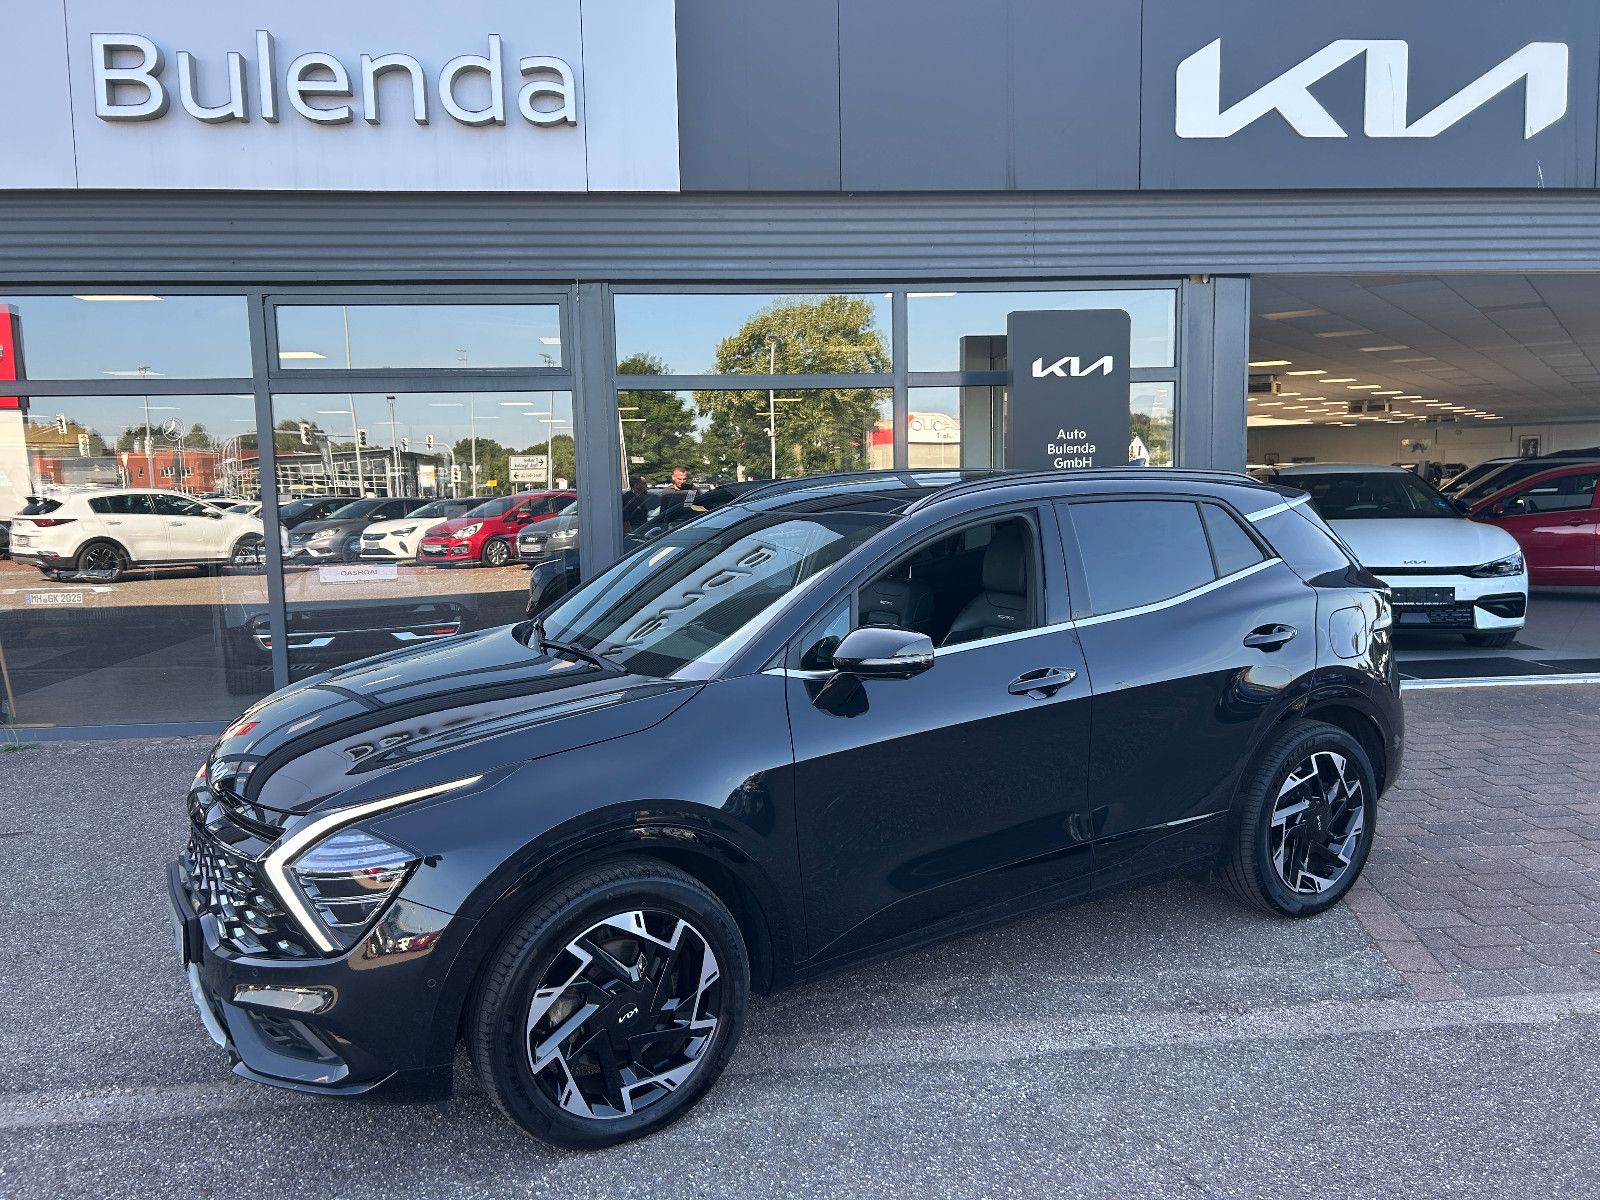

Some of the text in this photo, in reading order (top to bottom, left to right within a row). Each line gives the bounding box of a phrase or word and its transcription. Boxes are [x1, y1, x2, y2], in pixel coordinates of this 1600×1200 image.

[90, 30, 578, 127] Bulenda
[1175, 37, 1569, 139] KIA
[1032, 356, 1113, 377] KIA
[1056, 428, 1087, 440] Auto
[1047, 442, 1096, 455] Bulenda
[1054, 457, 1092, 469] GmbH
[340, 569, 378, 577] QASHQAI
[60, 593, 82, 603] 2025
